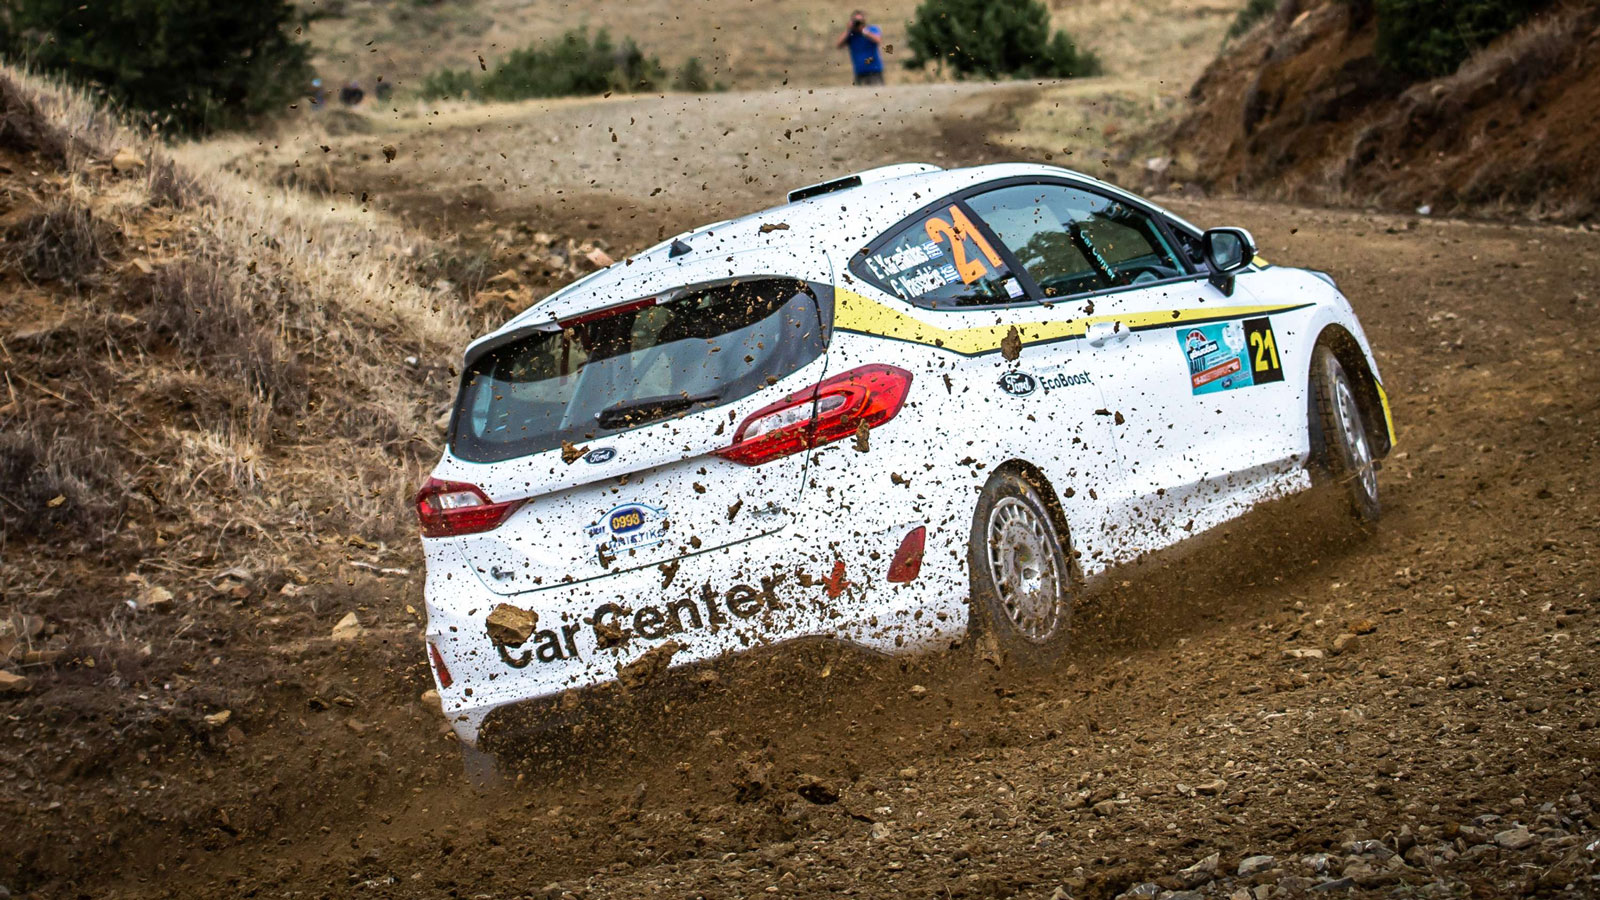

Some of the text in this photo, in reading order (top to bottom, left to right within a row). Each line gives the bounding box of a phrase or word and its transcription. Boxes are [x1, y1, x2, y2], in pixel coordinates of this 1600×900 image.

[925, 205, 1002, 285] 21
[1250, 329, 1279, 372] 21
[1004, 370, 1092, 394] Ford EcoBoost
[589, 450, 611, 463] Ford
[592, 574, 786, 650] Center
